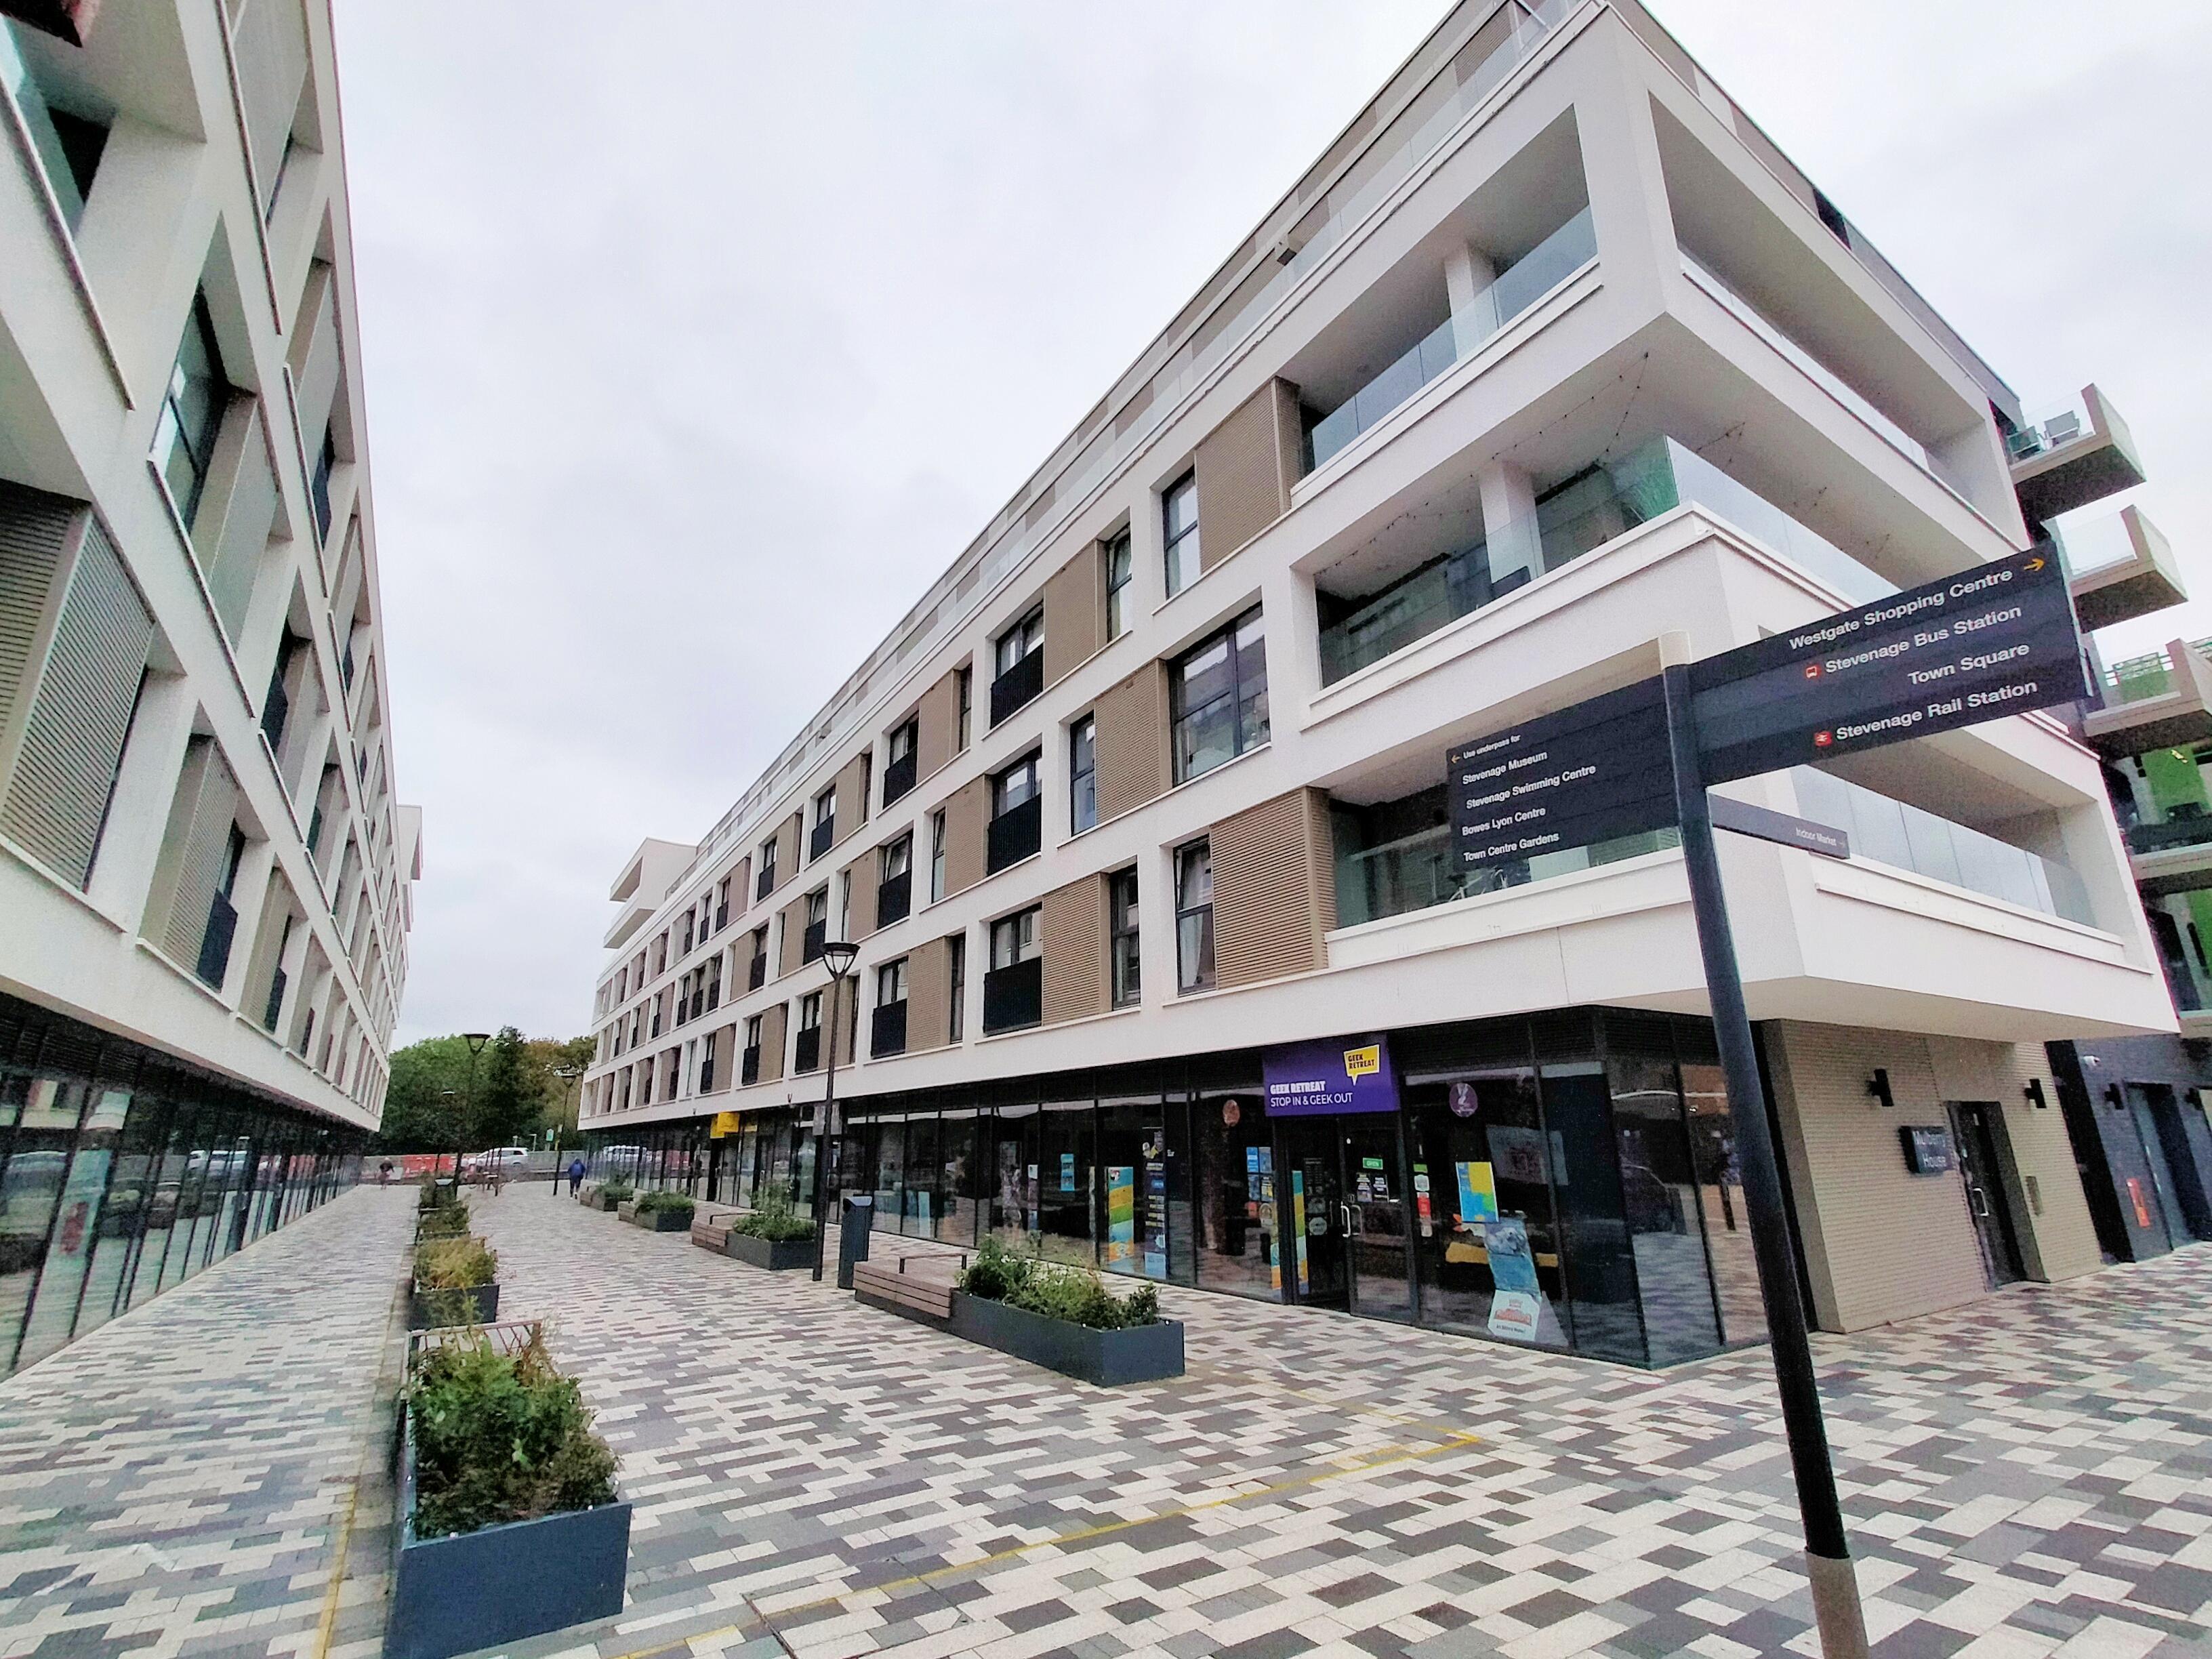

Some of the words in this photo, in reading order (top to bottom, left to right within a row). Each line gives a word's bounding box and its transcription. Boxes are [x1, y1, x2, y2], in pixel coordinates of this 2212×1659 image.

[1789, 619, 1860, 651] Westgate
[1864, 590, 1945, 626] Shopping
[1949, 569, 2013, 598] Centre
[1825, 640, 1910, 674] Stevenage
[1914, 629, 1950, 647] Bus
[1954, 607, 2022, 636] Station
[1908, 664, 1956, 685] Town
[1960, 643, 2030, 672] Square
[1836, 710, 1923, 741] Stevenage
[1927, 698, 1962, 718] Rail
[1967, 680, 2039, 708] Station
[1463, 751, 1476, 760] Use
[1476, 739, 1510, 754] underpass
[1511, 735, 1521, 743] for
[1462, 764, 1507, 785] Stevenage
[1508, 752, 1548, 771] Museum
[1466, 790, 1511, 809] Stevenage
[1512, 775, 1560, 796] Swimming
[1562, 764, 1596, 781] Centre
[1462, 822, 1490, 836] Bowes
[1492, 815, 1513, 830] Lyon
[1514, 807, 1546, 822] Centre
[1464, 851, 1486, 862] Town
[1488, 842, 1517, 856] Centre
[1519, 832, 1559, 849] Gardens
[1348, 1054, 1364, 1062] GEEK
[1349, 1059, 1375, 1069] RETREAT
[1270, 1084, 1290, 1094] GEEK
[1290, 1081, 1326, 1093] RETREAT
[1271, 1097, 1291, 1107] STOP
[1292, 1097, 1301, 1105] IN
[1303, 1096, 1309, 1105] &
[1310, 1094, 1333, 1105] GEEK
[1334, 1092, 1353, 1103] OUT
[1922, 1153, 1946, 1168] House
